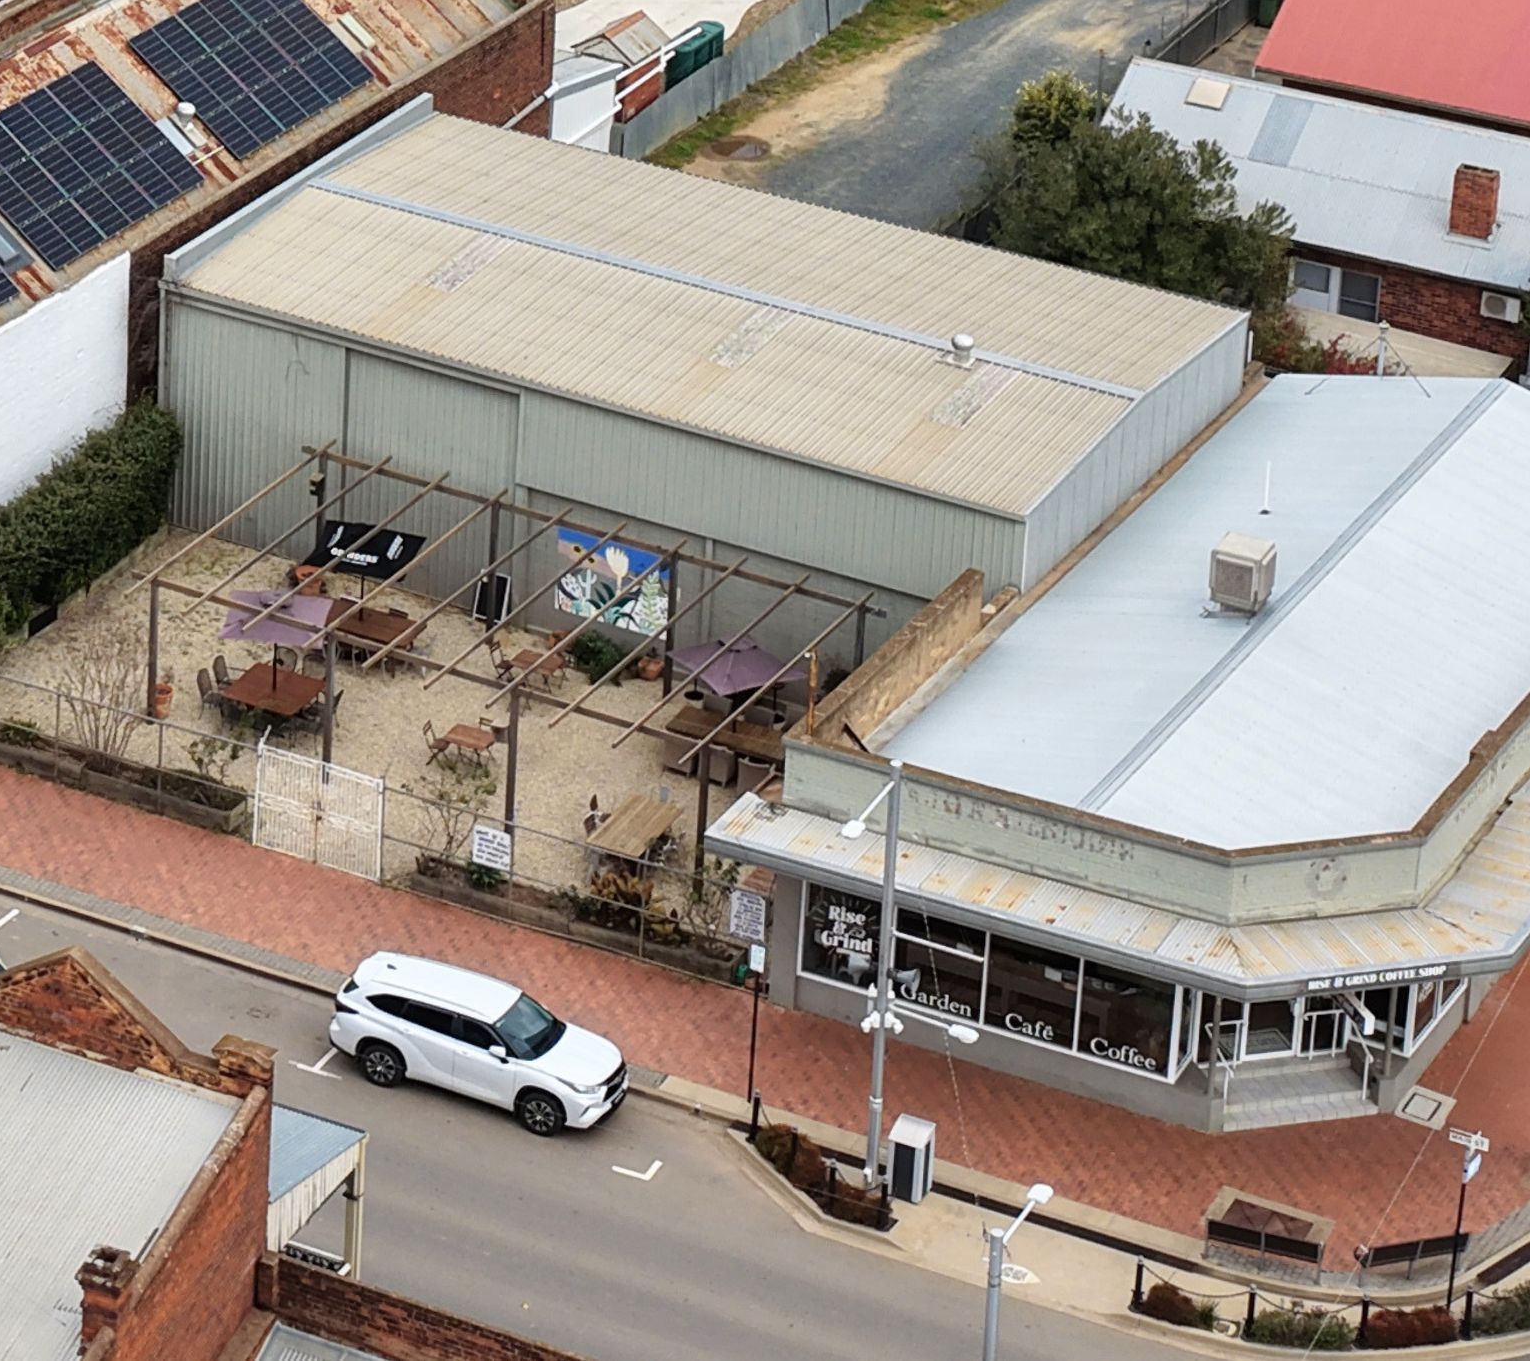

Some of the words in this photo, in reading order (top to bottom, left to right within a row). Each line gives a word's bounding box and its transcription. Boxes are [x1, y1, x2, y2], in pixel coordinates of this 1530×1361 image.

[827, 904, 868, 926] Rise
[820, 930, 874, 954] Grind
[1345, 973, 1378, 986] GRIND
[1418, 965, 1447, 978] SHOP
[899, 981, 973, 1018] Garden
[1089, 1035, 1158, 1072] Coffee
